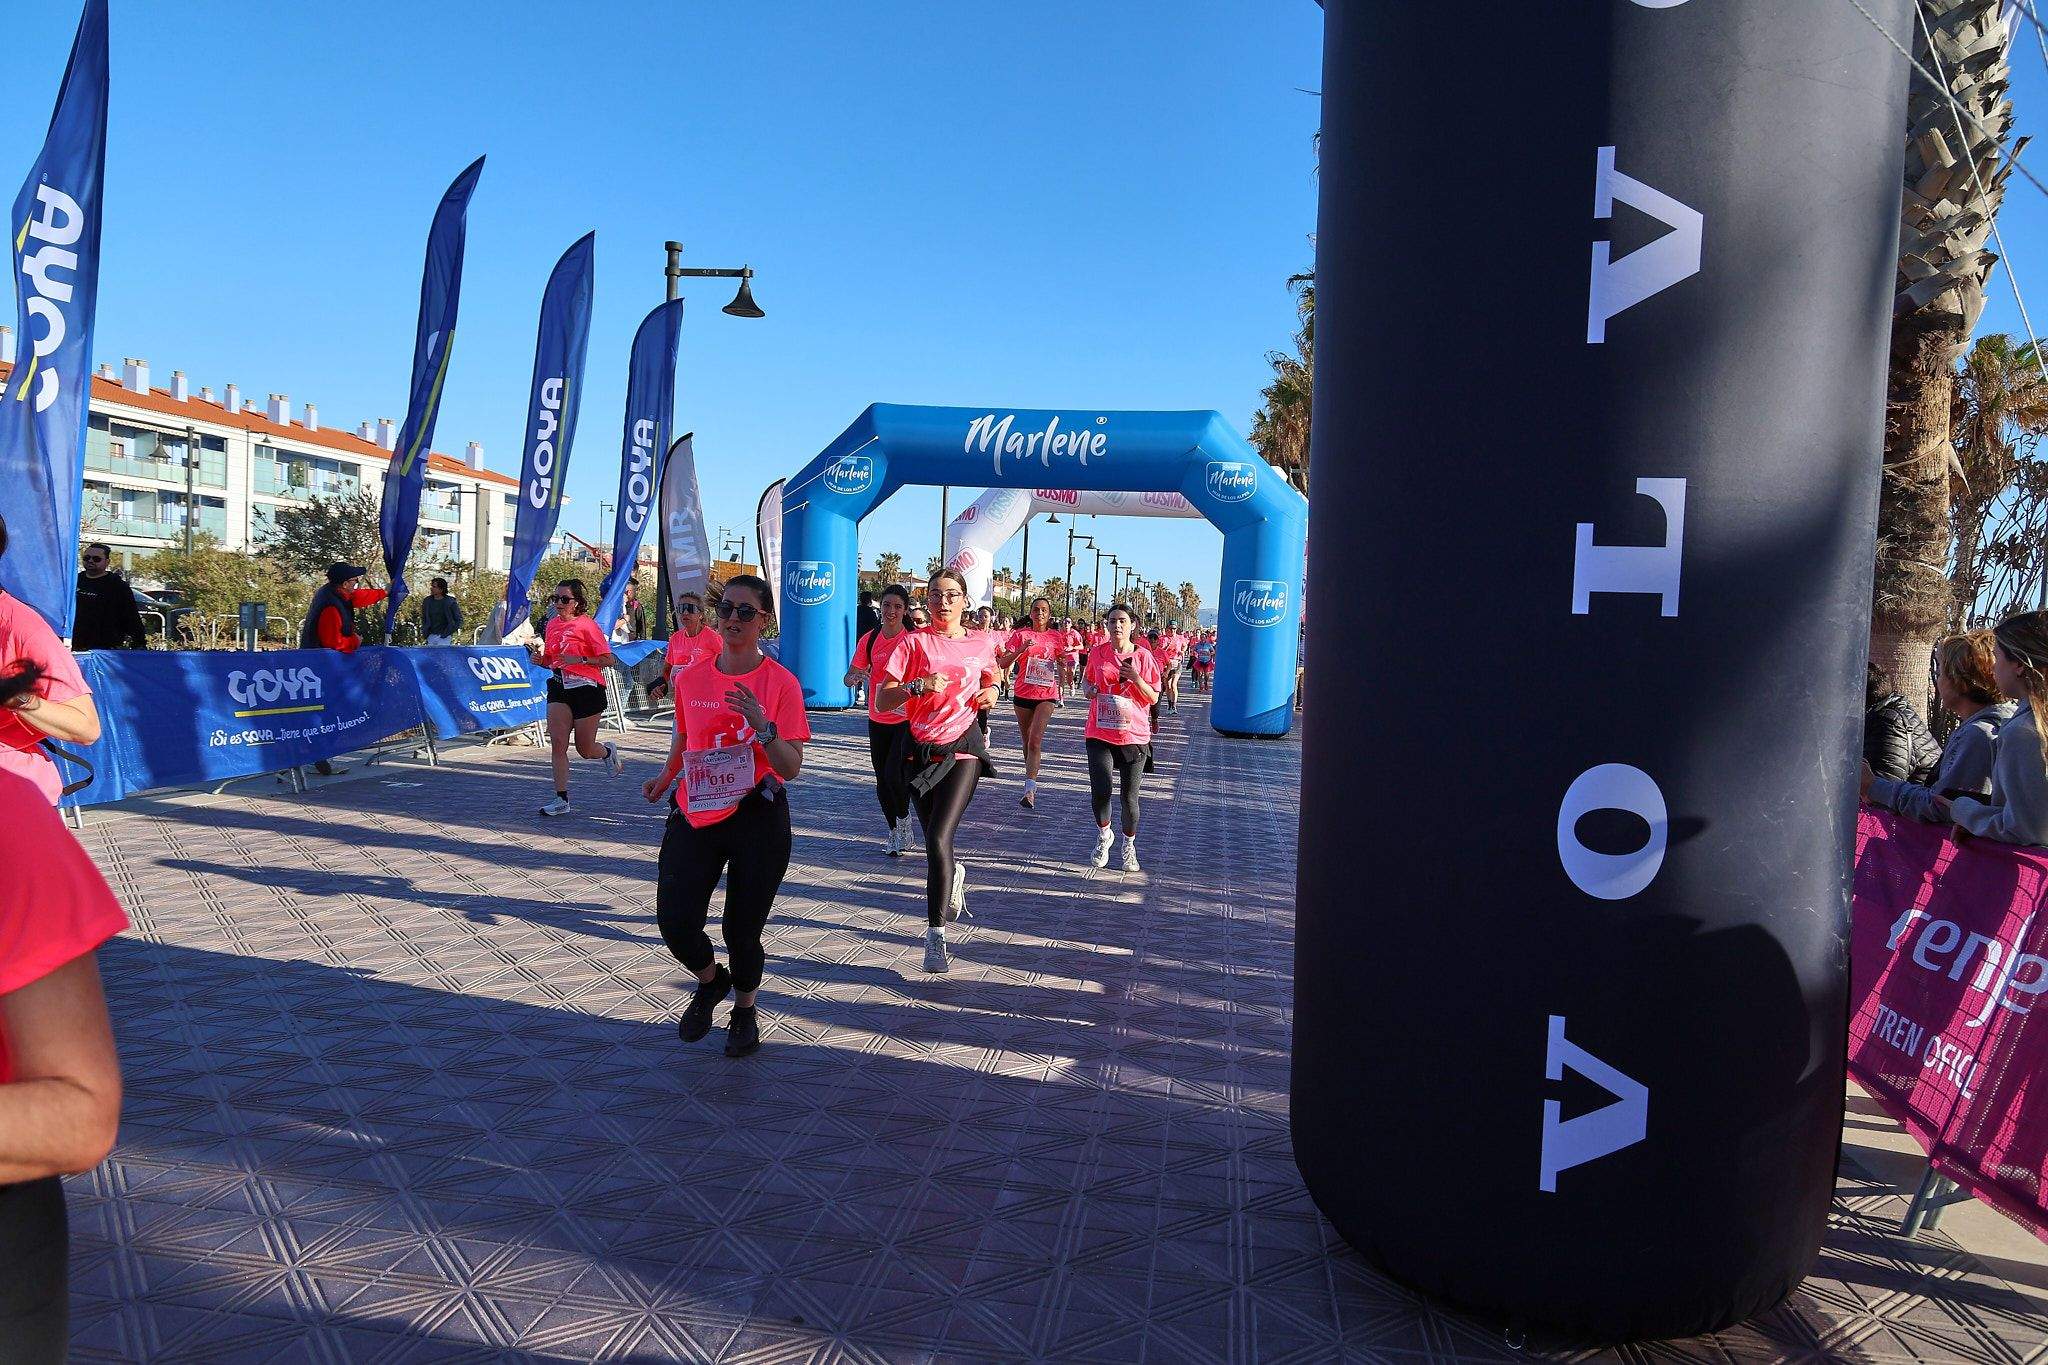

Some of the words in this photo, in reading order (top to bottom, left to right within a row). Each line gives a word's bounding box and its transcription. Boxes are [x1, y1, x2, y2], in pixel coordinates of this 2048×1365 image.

[529, 377, 563, 509] GOYA
[964, 414, 1107, 476] Marlene
[625, 418, 654, 532] GOYA
[827, 464, 869, 483] Marlene
[1209, 470, 1254, 491] Marlene
[788, 570, 831, 593] Marlene
[1539, 0, 1704, 1193] VOLV
[1236, 590, 1284, 613] Marlene
[467, 656, 527, 684] GOYA
[228, 667, 322, 708] GOYA
[690, 700, 720, 709] OYSHO
[229, 734, 242, 745] es
[243, 729, 274, 746] GOYA
[302, 726, 318, 744] que
[320, 723, 335, 733] ser
[338, 710, 370, 731] bueno!
[709, 773, 735, 786] 016
[1872, 1003, 1924, 1057] TREN
